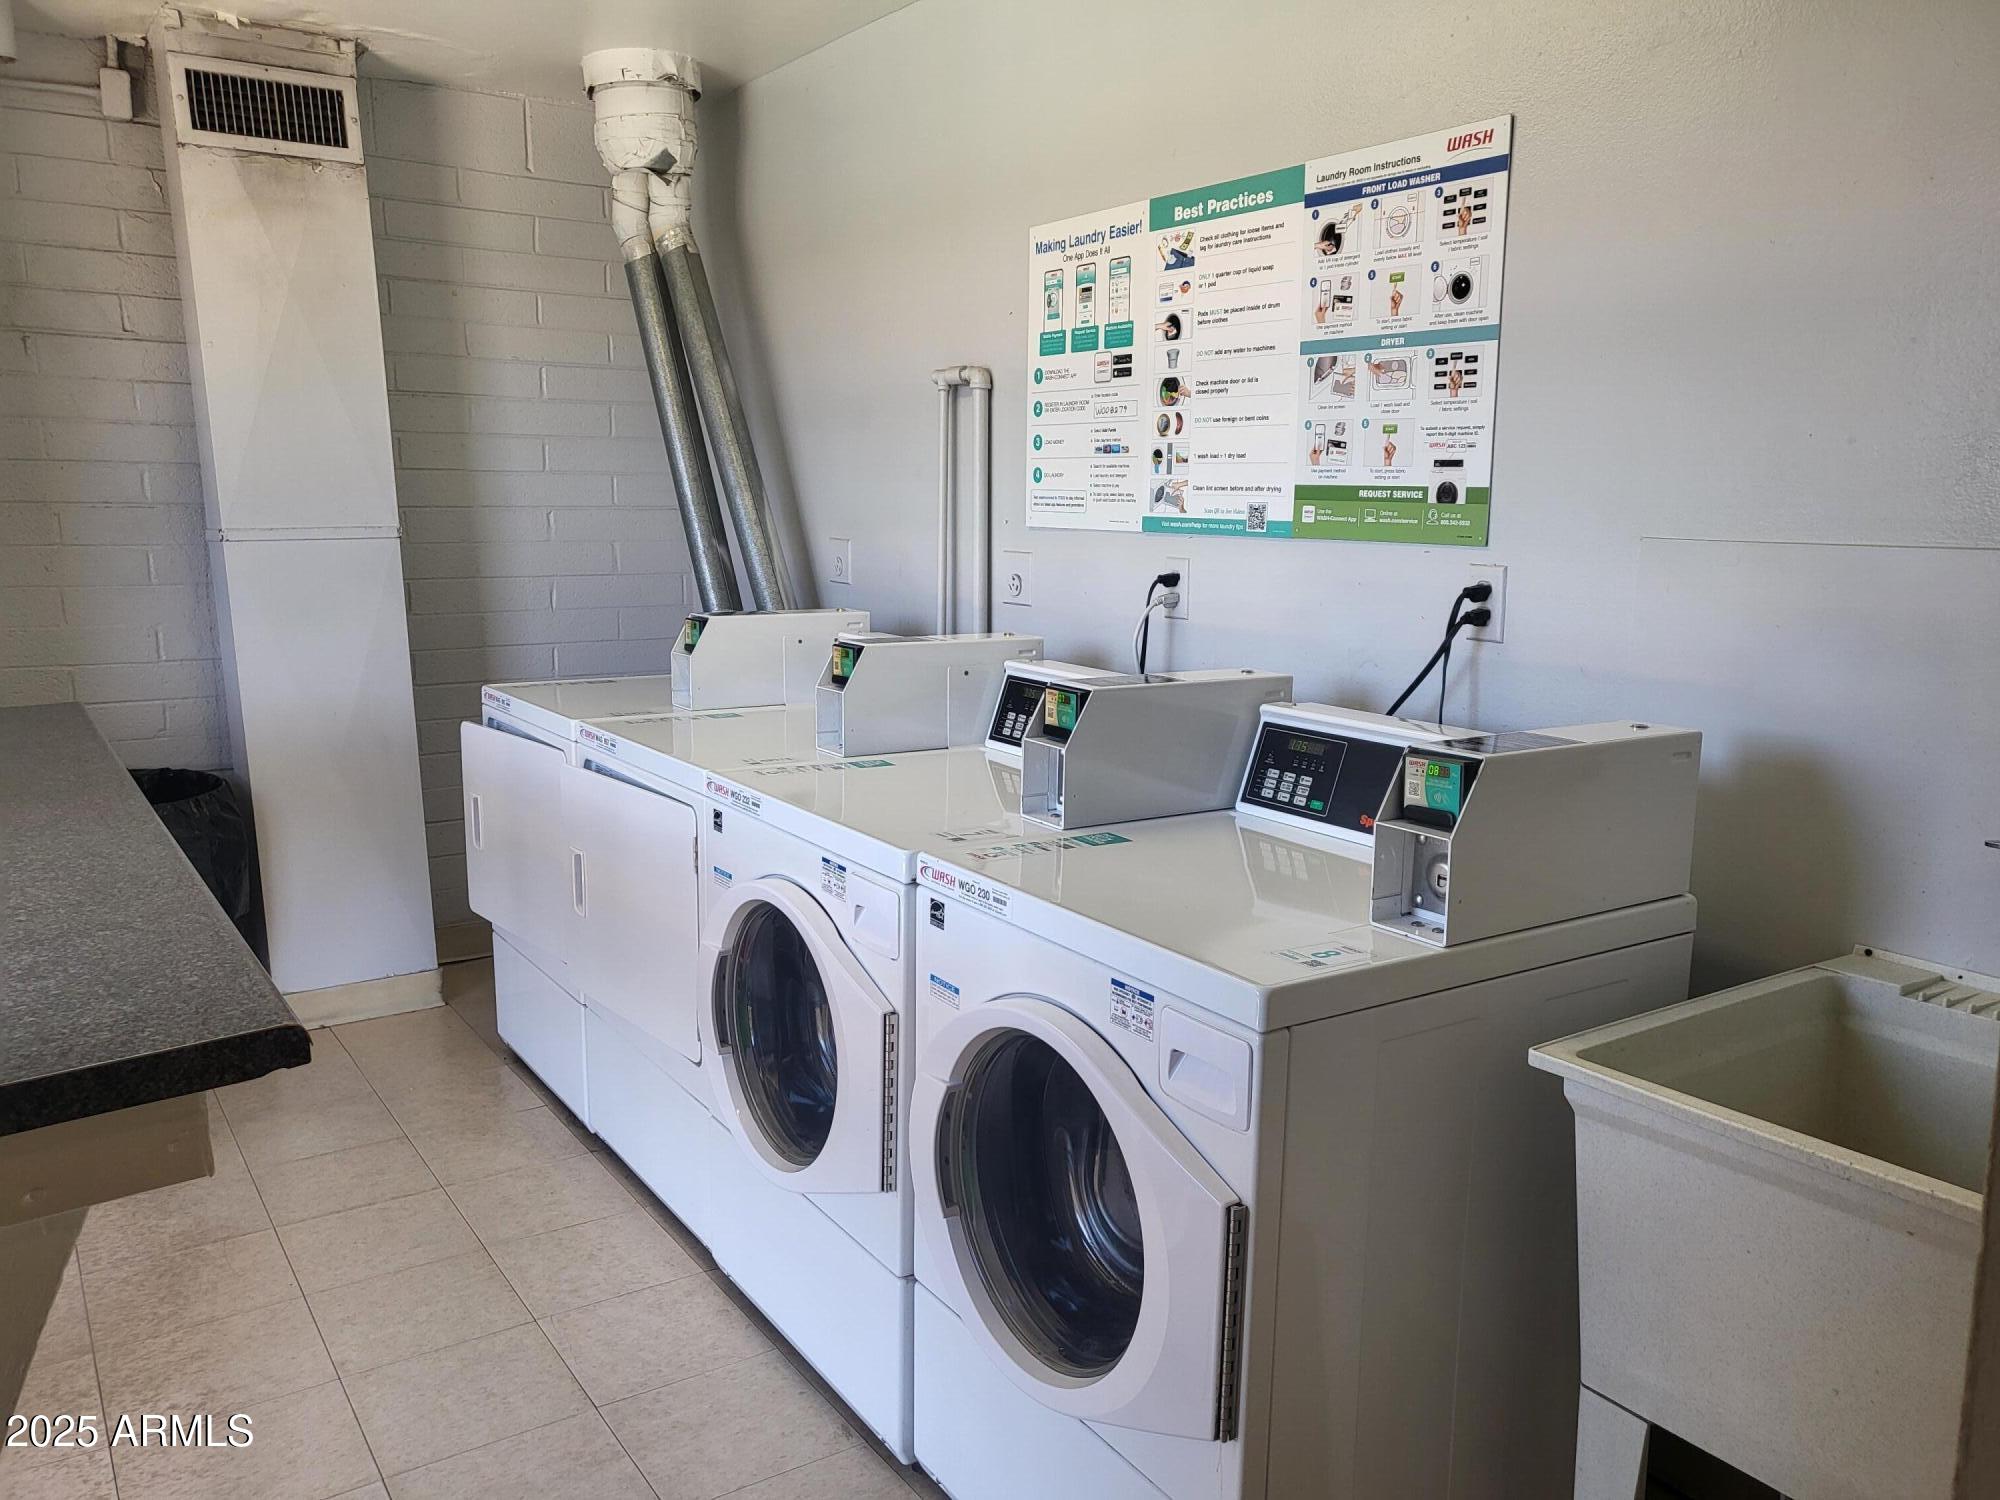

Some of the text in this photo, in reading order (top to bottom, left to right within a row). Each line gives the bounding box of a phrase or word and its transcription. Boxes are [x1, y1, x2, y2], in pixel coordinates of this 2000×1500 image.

[1446, 128, 1494, 152] WASH
[1316, 155, 1420, 182] Laundry Room Instructions
[1362, 172, 1441, 195] FRONT LOAD WASHER
[1174, 190, 1274, 222] Best Practices
[1036, 220, 1142, 255] Making Laundry Easier!
[1214, 241, 1231, 249] laundry
[1244, 234, 1272, 244] instructions
[1220, 231, 1239, 240] clothing
[1063, 254, 1073, 262] One
[1074, 252, 1084, 260] App
[1086, 250, 1098, 258] Does
[1216, 270, 1232, 278] quarter
[1248, 266, 1262, 274] liquid
[1230, 306, 1246, 314] placed
[1381, 337, 1405, 347] DRYER
[1210, 388, 1229, 396] properly
[1393, 490, 1424, 499] SERVICE
[1428, 765, 1439, 776] 08
[714, 784, 729, 796] WASH
[932, 868, 990, 901] WASH WGO 230
